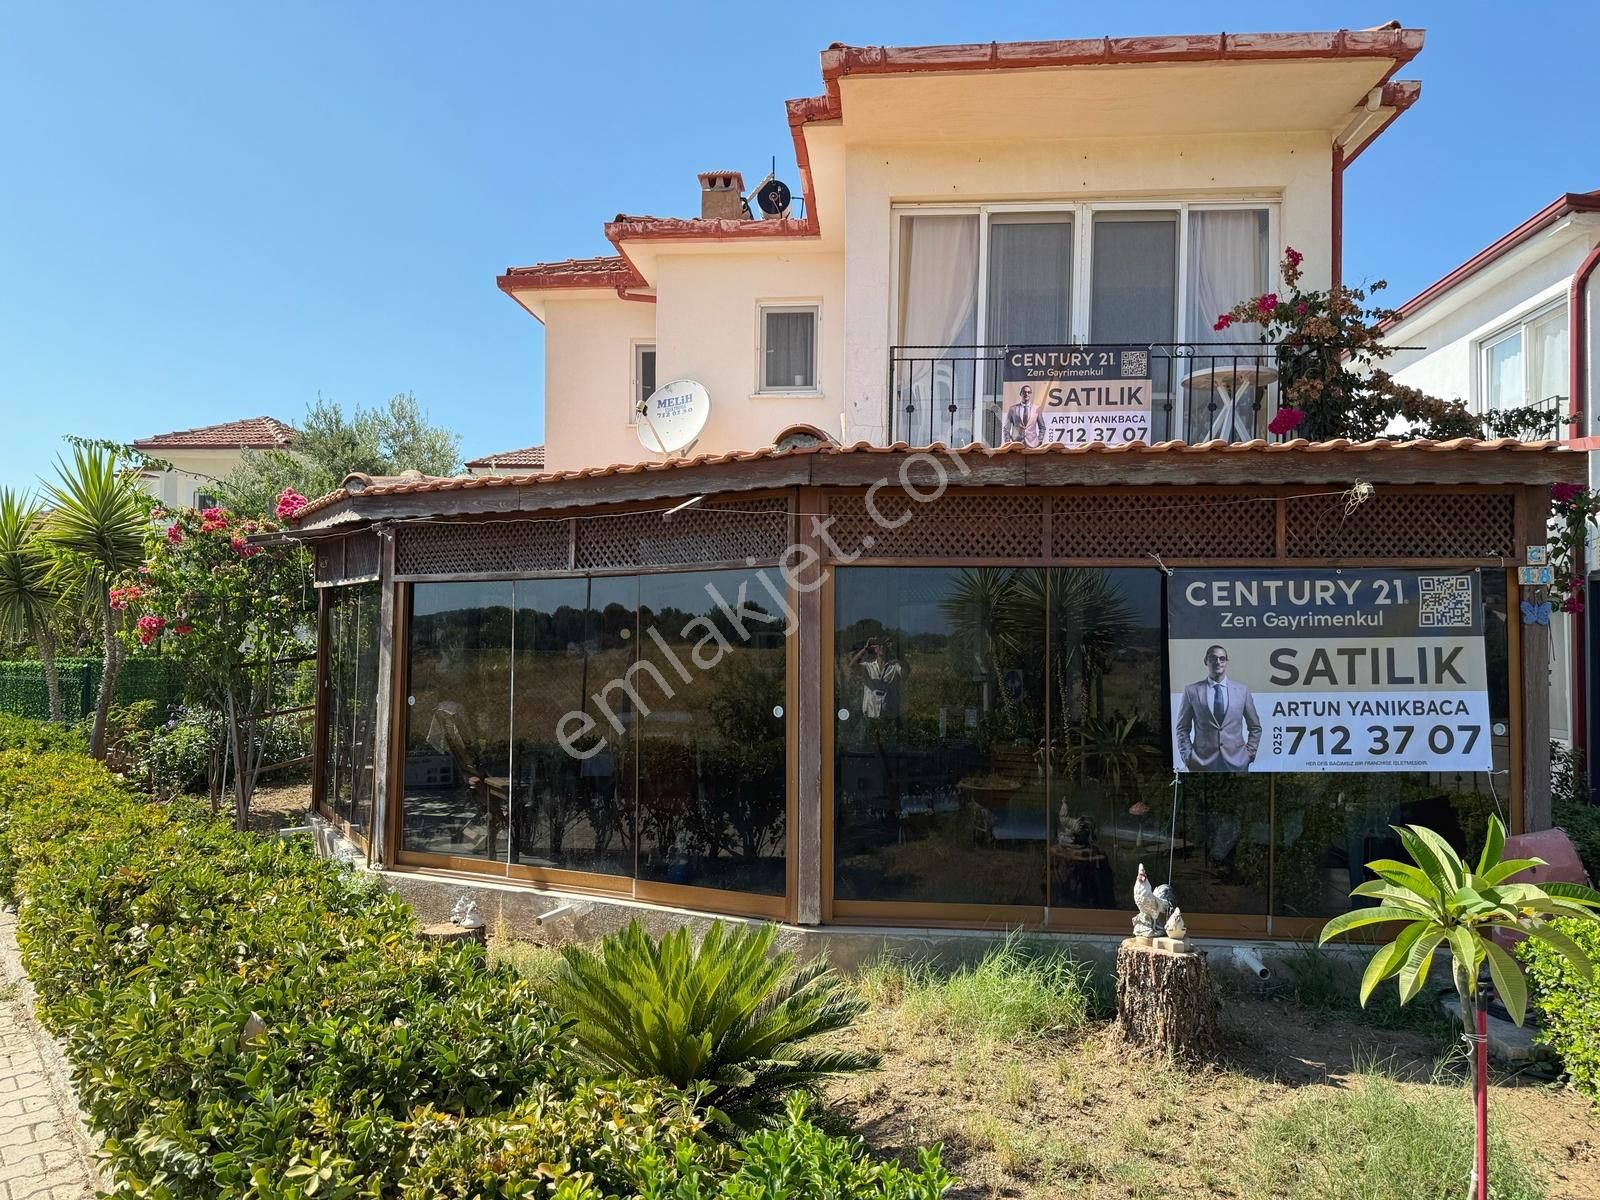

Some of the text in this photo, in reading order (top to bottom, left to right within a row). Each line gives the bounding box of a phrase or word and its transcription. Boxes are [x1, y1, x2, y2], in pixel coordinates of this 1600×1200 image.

[1011, 352, 1114, 366] CENTURY 21
[1027, 368, 1104, 378] Zen Gayrimenkul
[1048, 386, 1144, 407] SATILIK
[1051, 415, 1146, 424] ARTUN YANIKBACA
[1055, 427, 1148, 443] 712 37 07
[1185, 579, 1403, 607] CENTURY 21
[1220, 610, 1384, 631] Zen Gayrimenkul
[1269, 646, 1467, 686] SATILIK
[1272, 699, 1470, 717] ARTUN YANIKBACA
[1273, 726, 1283, 755] 0252
[1285, 724, 1482, 755] 712 37 07
